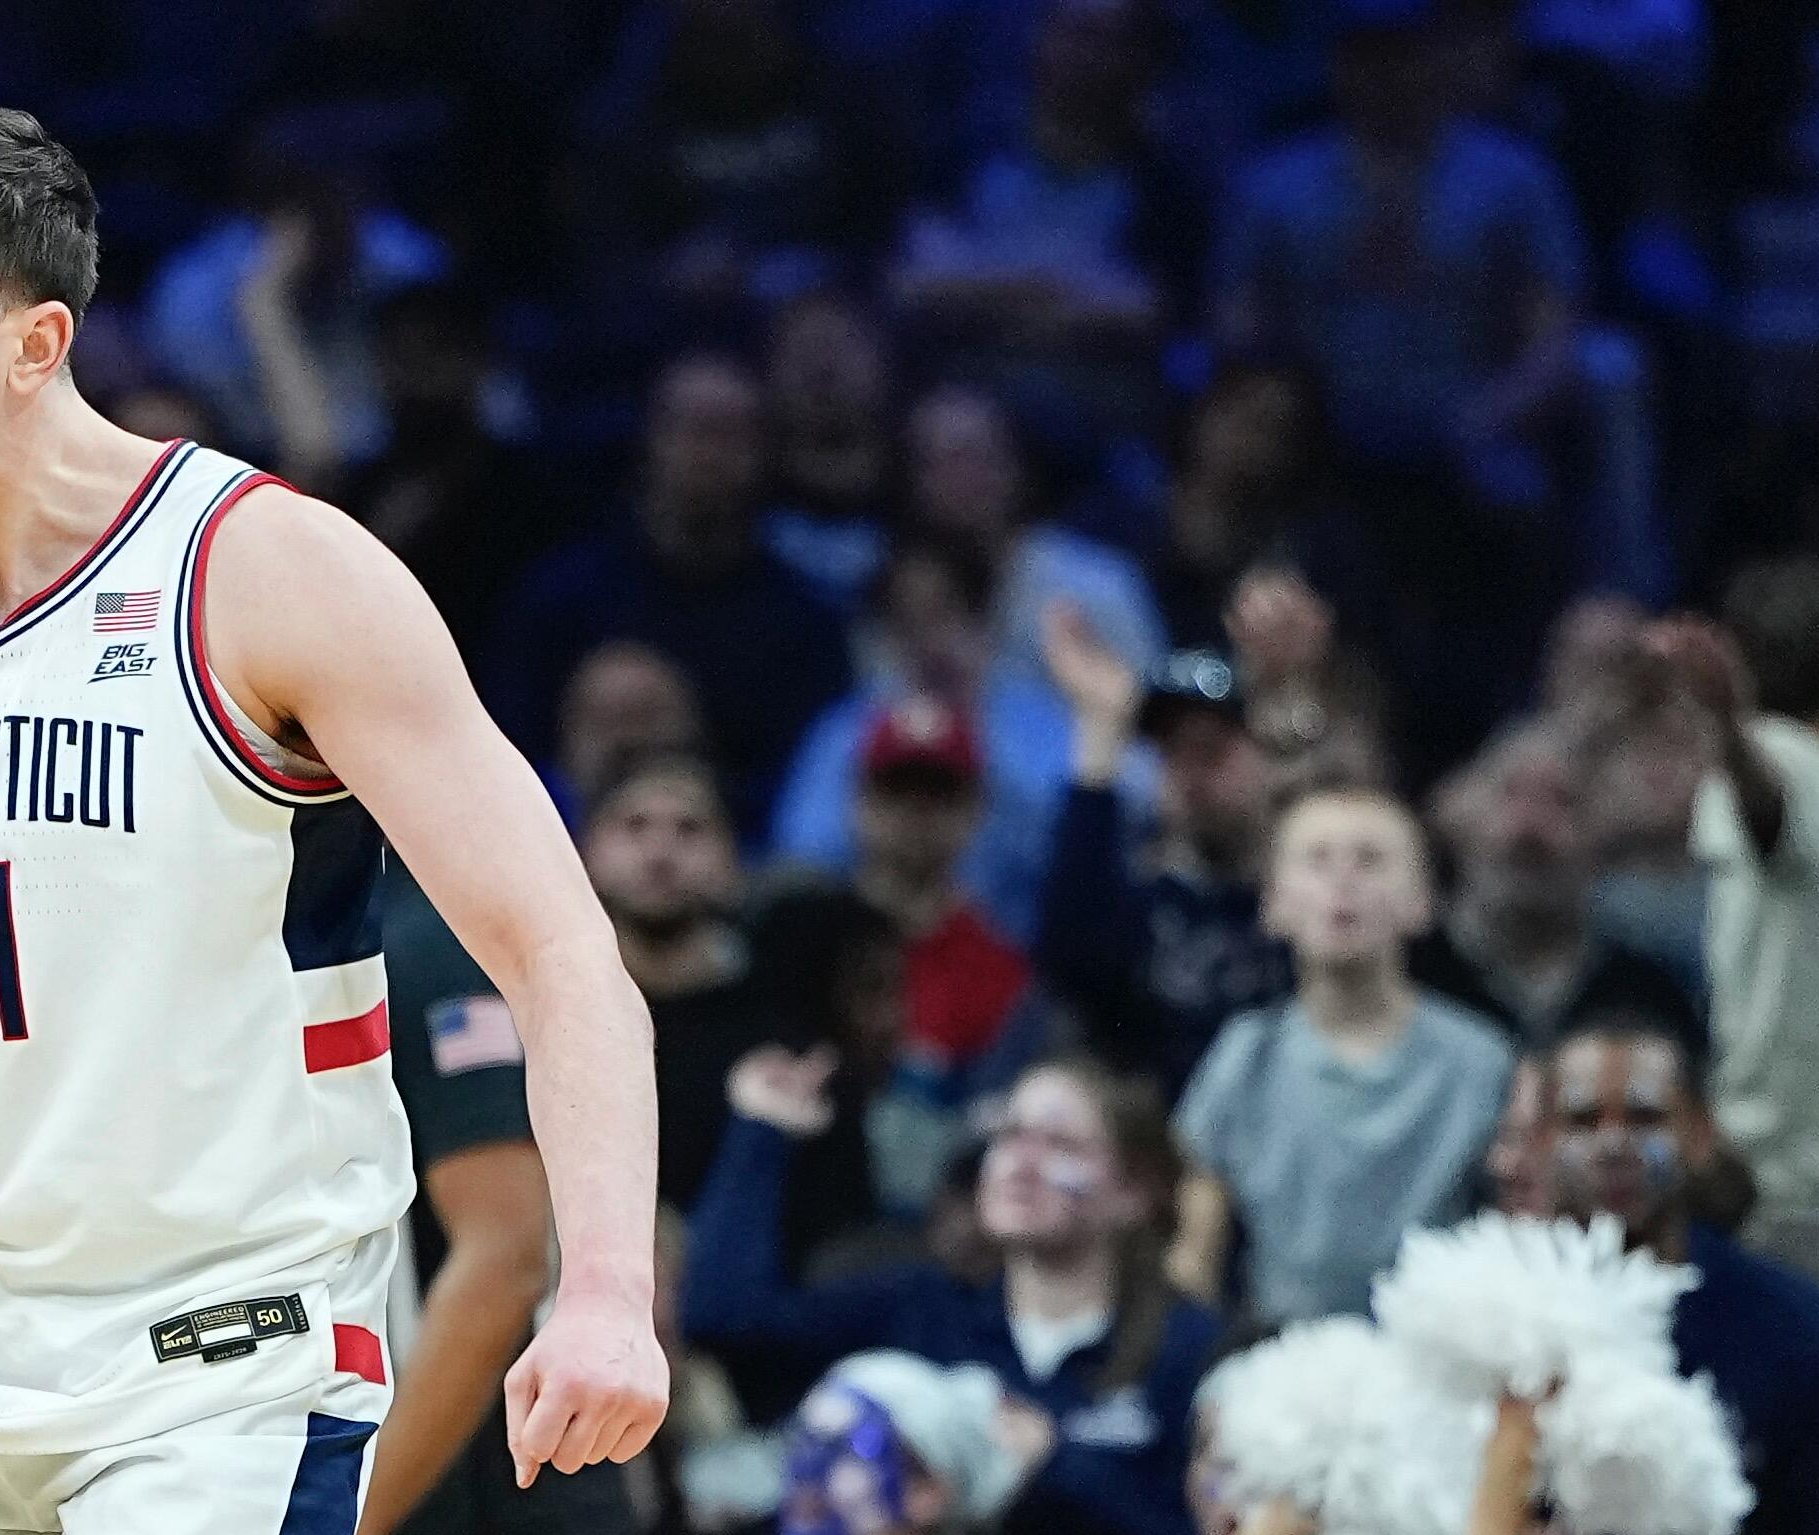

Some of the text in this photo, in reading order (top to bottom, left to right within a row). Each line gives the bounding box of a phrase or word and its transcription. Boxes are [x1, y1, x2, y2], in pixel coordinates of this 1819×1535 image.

[102, 642, 149, 659] BIG
[94, 658, 158, 674] EAST
[256, 1308, 283, 1327] 50
